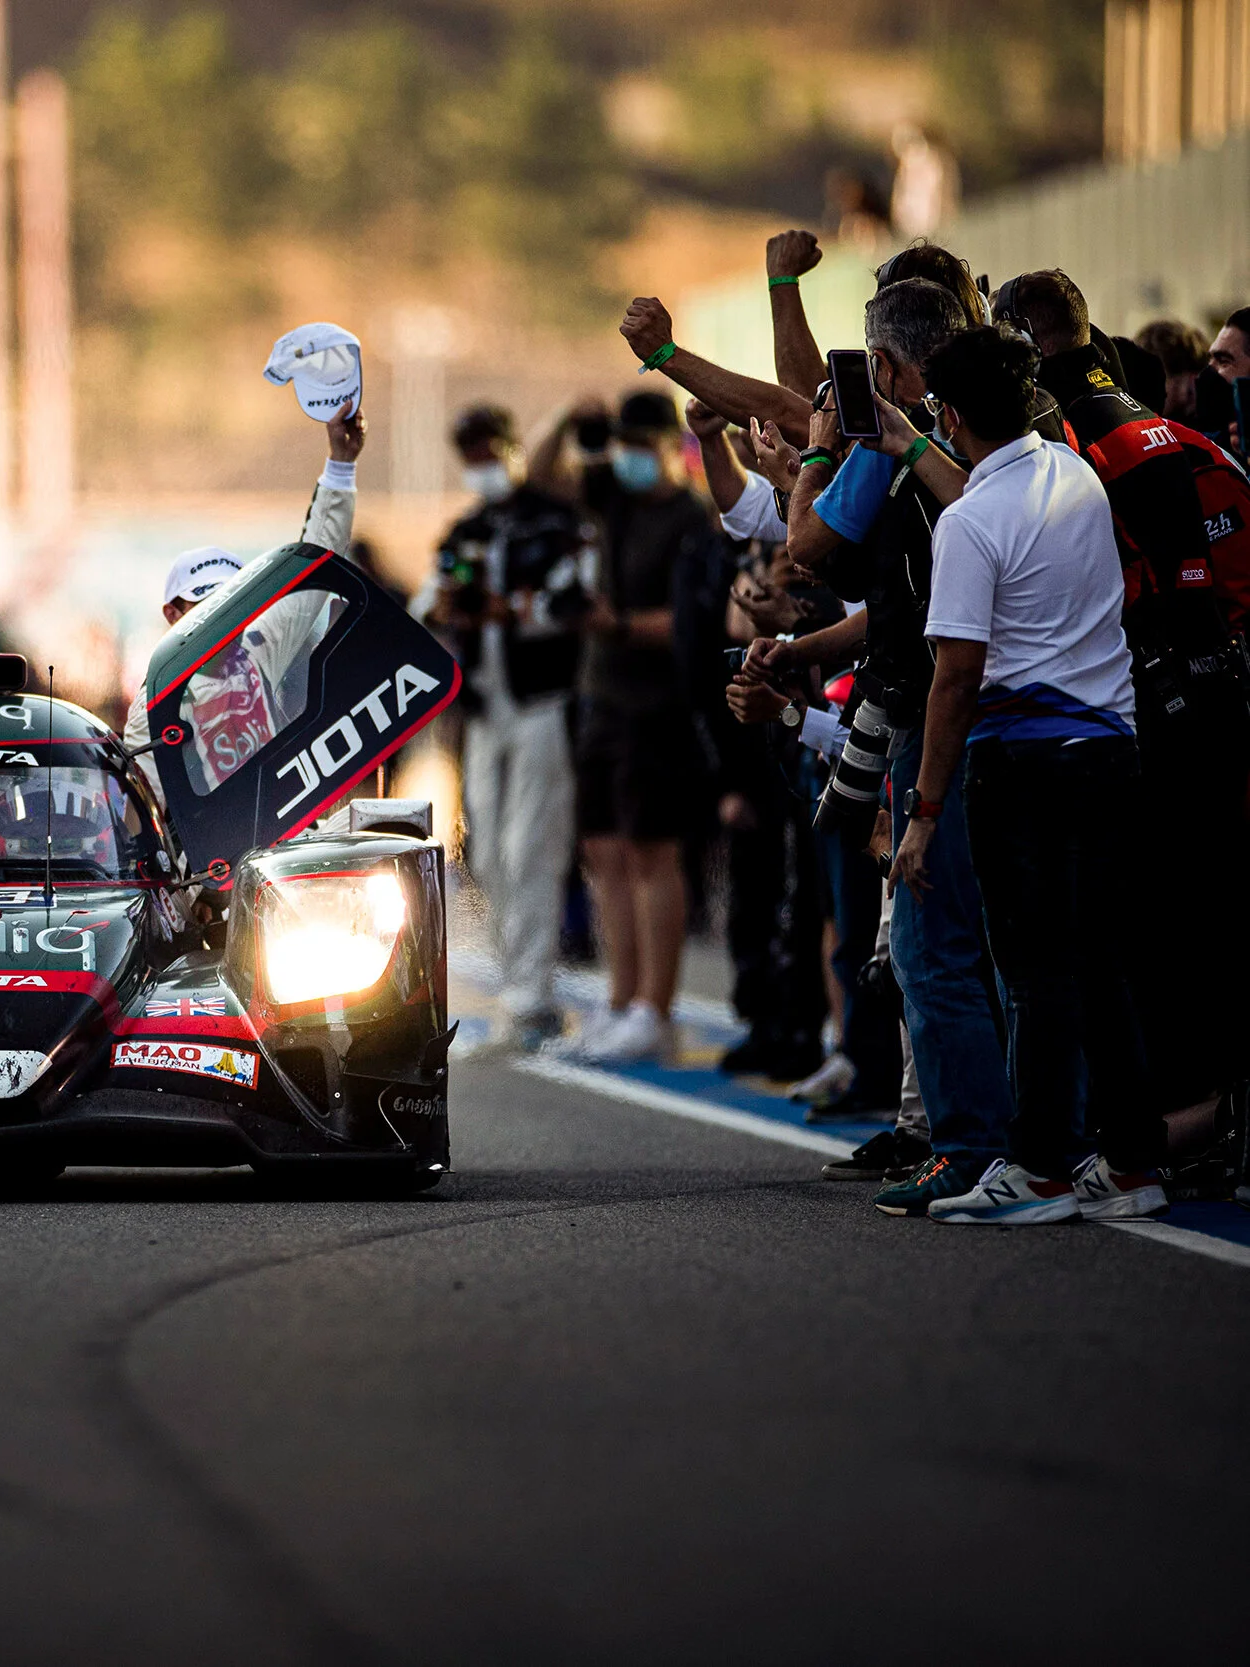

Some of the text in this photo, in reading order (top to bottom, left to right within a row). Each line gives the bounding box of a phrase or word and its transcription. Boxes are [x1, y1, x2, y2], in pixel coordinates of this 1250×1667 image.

[1141, 426, 1178, 451] JOT
[276, 664, 441, 819] JOTA
[121, 1044, 201, 1061] MAO
